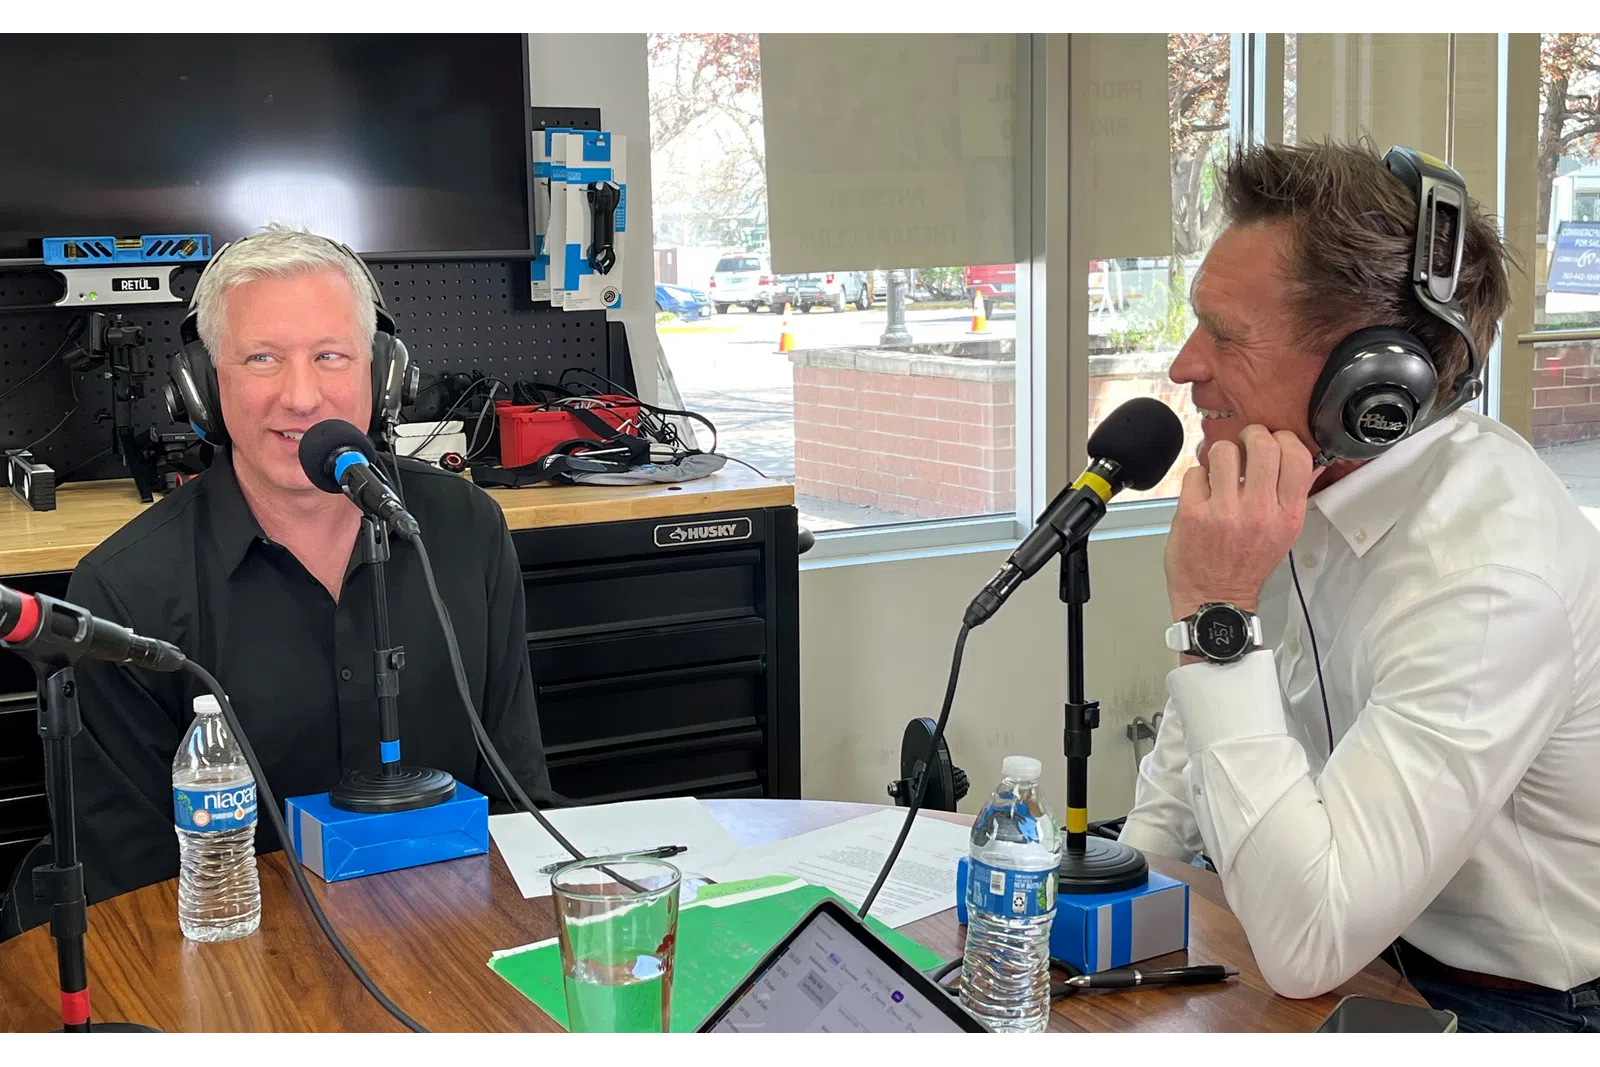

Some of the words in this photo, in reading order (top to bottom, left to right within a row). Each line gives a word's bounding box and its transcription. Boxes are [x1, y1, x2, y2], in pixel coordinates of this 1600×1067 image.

[1574, 238, 1588, 247] FOR
[1588, 239, 1600, 248] SAL
[687, 523, 737, 540] HUSKY
[204, 785, 257, 811] niagar
